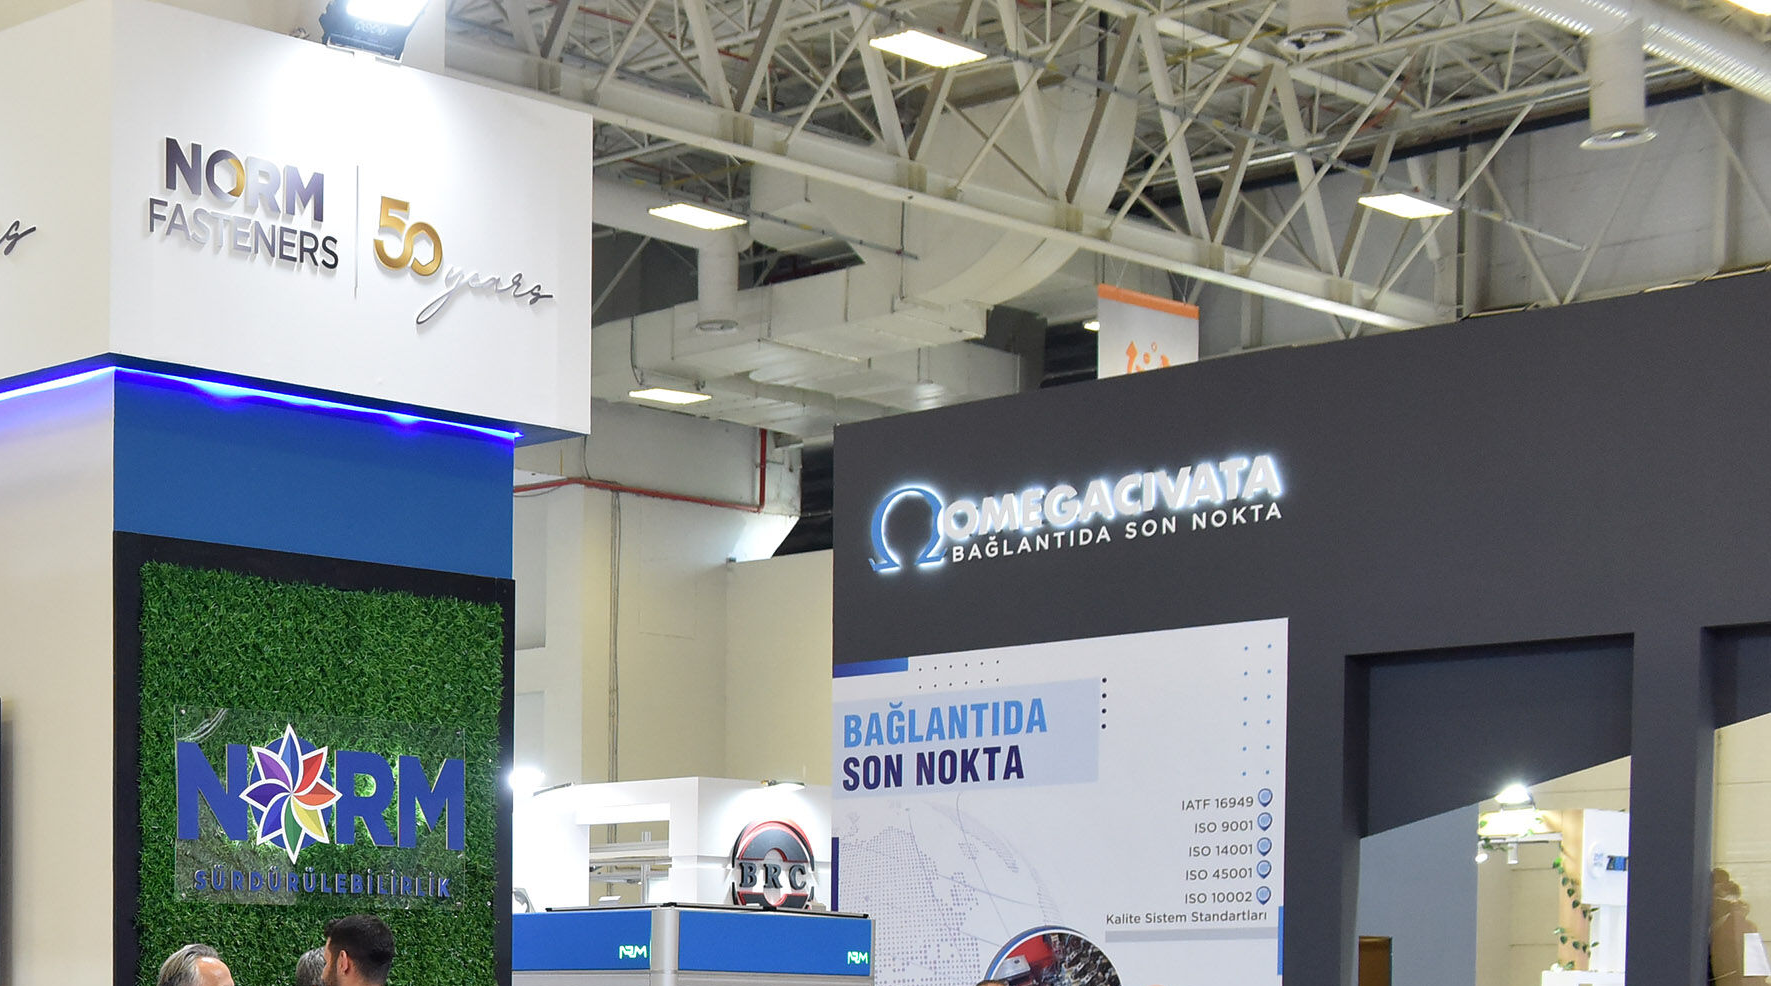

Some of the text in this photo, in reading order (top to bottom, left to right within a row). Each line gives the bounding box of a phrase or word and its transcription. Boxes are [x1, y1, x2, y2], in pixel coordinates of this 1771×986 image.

[165, 137, 324, 222] NORM
[149, 197, 339, 269] FASTENERS
[373, 196, 553, 325] 50 years
[942, 455, 1283, 539] OMEGACIVATA
[952, 502, 1282, 562] BAĞLANTIDA SON NOKTA
[843, 698, 1048, 748] BAĞLANTIDA
[842, 745, 1024, 791] SON NOKTA
[176, 723, 465, 864] NORM
[1181, 796, 1254, 811] IATF 16949
[1194, 820, 1253, 833] ISO 9001
[1188, 844, 1253, 857] ISO 14001
[194, 865, 451, 898] SÜRDÜRÜLEBİLİRLİK
[739, 862, 807, 890] BRC
[1185, 867, 1253, 880] ISO 45001
[1185, 891, 1252, 904] ISO 10002
[1106, 910, 1267, 925] Kalite Sistem Standartları
